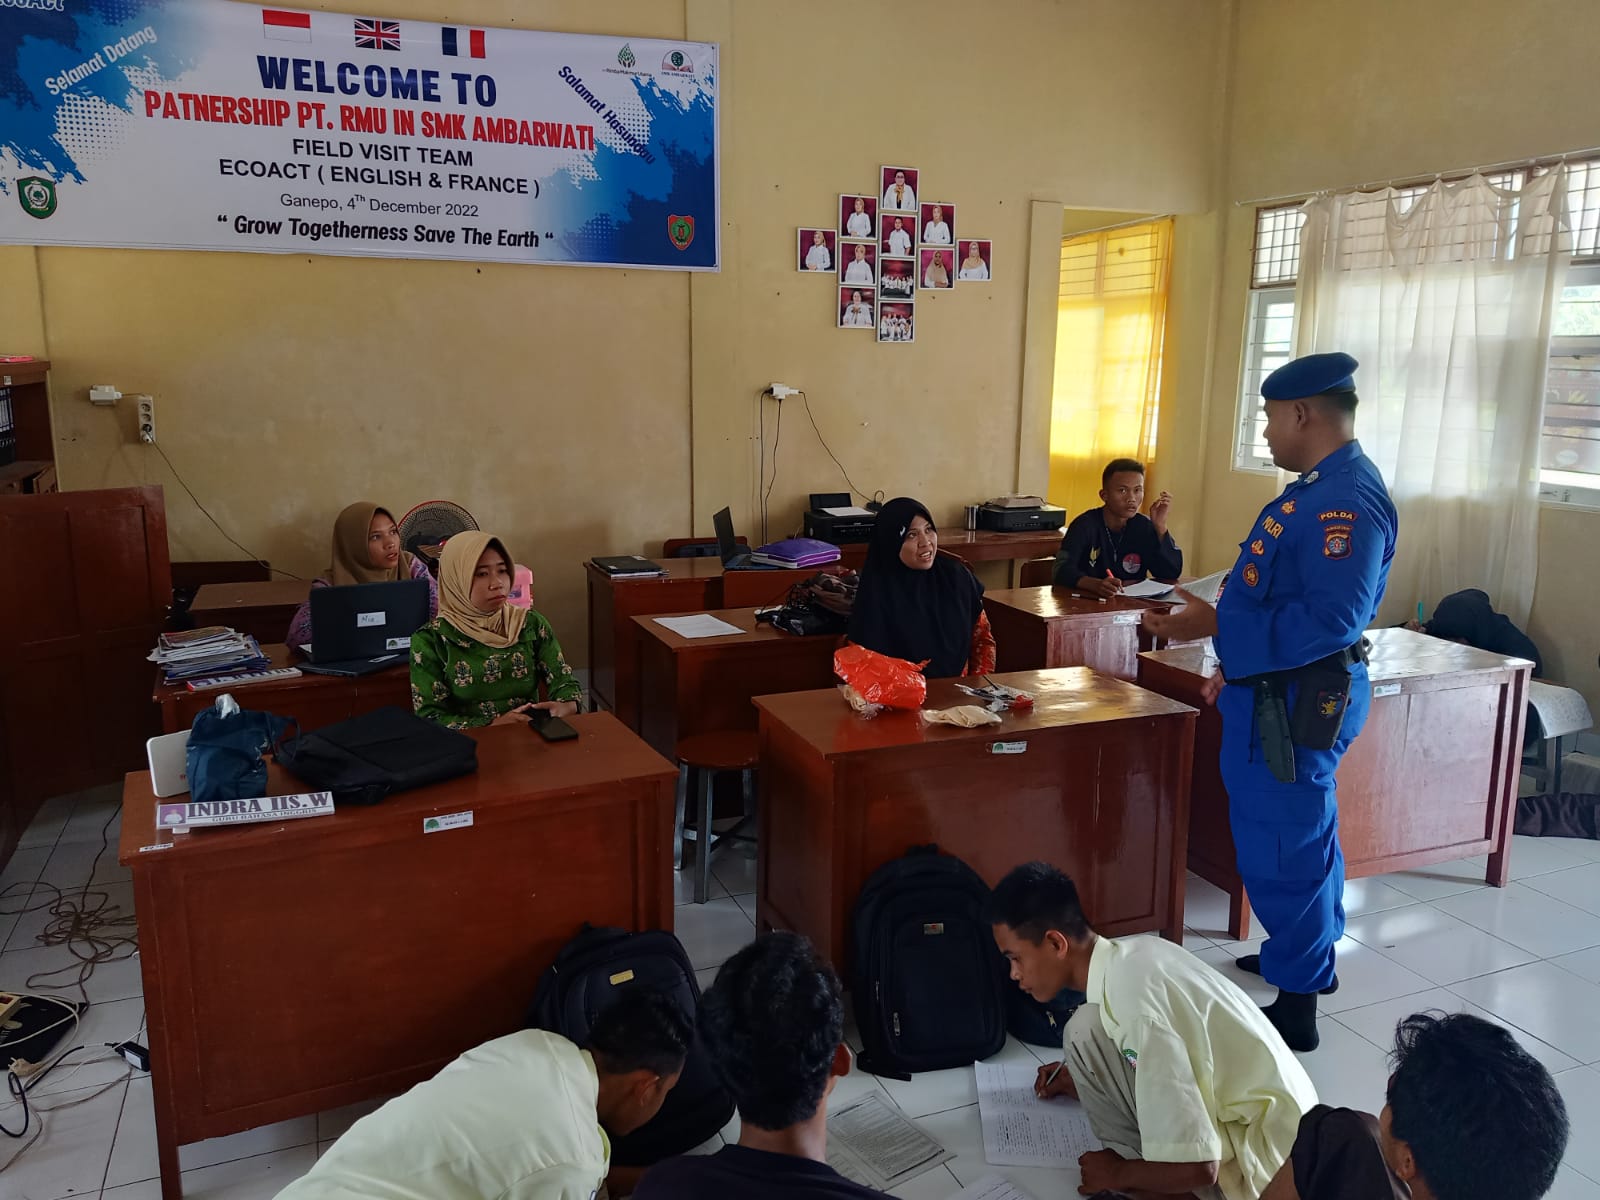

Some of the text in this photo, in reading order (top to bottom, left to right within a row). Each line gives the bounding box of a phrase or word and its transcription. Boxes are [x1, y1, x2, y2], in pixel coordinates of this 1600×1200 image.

[45, 25, 157, 96] Selamat Datang
[256, 55, 497, 107] WELCOME TO
[558, 65, 606, 114] Salamat
[144, 90, 594, 151] PATNERSHIP PT. RMU IN SMK AMBARWATI
[292, 138, 473, 167] FIELD VISIT TEAM
[219, 159, 310, 180] ECOACT
[331, 166, 422, 188] ENGLISH
[428, 172, 442, 189] &
[449, 174, 529, 195] FRANCE
[280, 193, 343, 212] Ganepo,
[369, 198, 441, 215] December
[445, 203, 479, 217] 2022
[234, 216, 282, 235] Grow
[289, 218, 408, 242] Togetherness
[414, 224, 455, 243] Save
[461, 227, 492, 246] The
[498, 230, 539, 247] Earth
[1320, 511, 1354, 520] POLDA
[187, 799, 262, 818] INDRA
[240, 810, 277, 821] BAHASA
